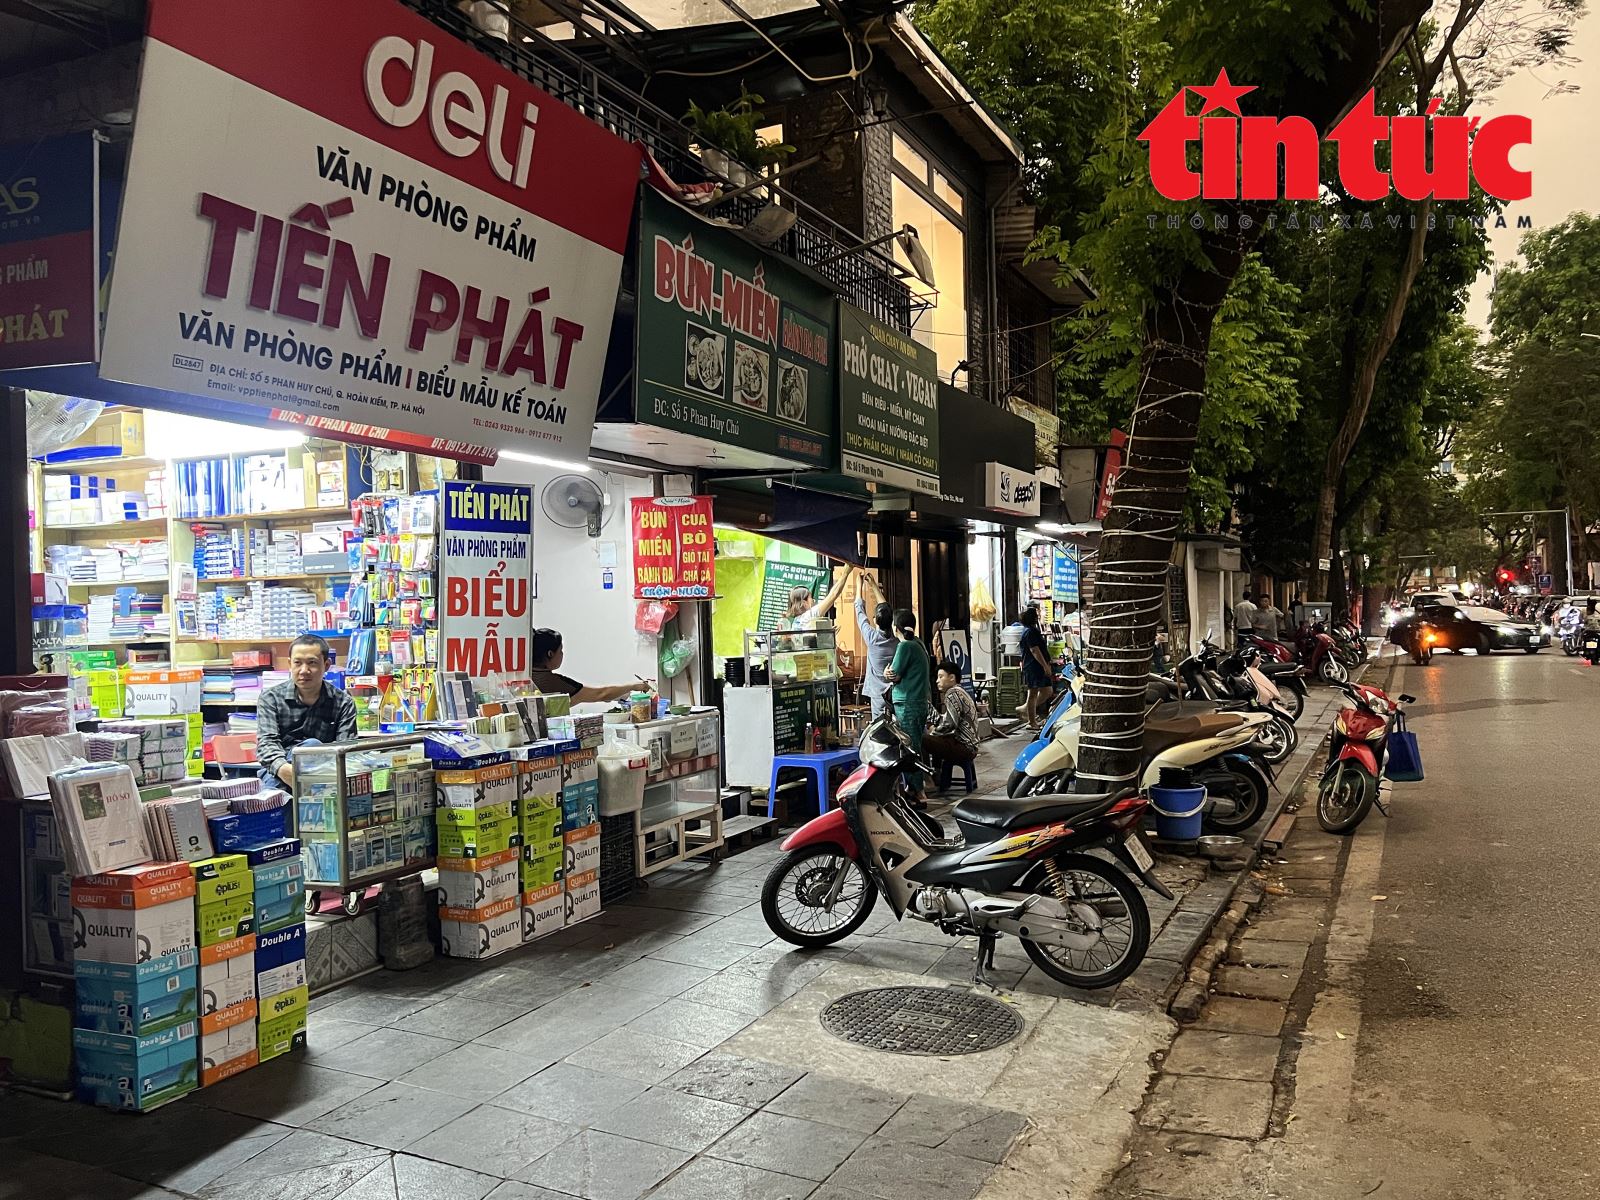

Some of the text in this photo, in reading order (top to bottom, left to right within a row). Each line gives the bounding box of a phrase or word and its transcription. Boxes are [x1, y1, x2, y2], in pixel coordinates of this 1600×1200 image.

[364, 36, 539, 189] deli
[316, 145, 537, 262] VĂN PHÒNG PHẨM
[7, 253, 48, 283] PHẨM
[199, 192, 584, 389] TIẾN PHÁT
[0, 304, 69, 344] HÁT
[179, 310, 567, 424] VĂN PHÒNG PHẨM BIỂU MẪU KẾ TOÁN
[844, 335, 937, 410] PHỞ CHAY VEGAN
[207, 379, 340, 412] Email: vpptienphat@gmail.com
[210, 363, 225, 376] ĐỊA
[229, 366, 248, 380] CHỈ:
[250, 369, 262, 382] SỐ
[264, 376, 269, 384] 5
[272, 377, 295, 390] PHAN
[297, 382, 314, 394] HUY
[346, 391, 368, 403] HOÀN
[370, 394, 388, 409] KIẾM,
[390, 402, 399, 411] TP.
[402, 402, 411, 412] HÀ
[413, 404, 425, 416] NỘI
[319, 416, 346, 432] PHAN
[654, 398, 669, 416] ĐC:
[672, 399, 681, 420] Số
[683, 406, 688, 422] 5
[690, 408, 708, 428] Phan
[710, 413, 725, 435] Huy
[912, 413, 925, 426] CHAY
[447, 438, 496, 459] 0912.877.912
[846, 431, 863, 449] THỰC
[880, 442, 896, 457] CHAY
[449, 484, 529, 521] TIẾN PHÁT
[641, 508, 667, 528] BÚN
[681, 514, 707, 526] CUA
[639, 533, 672, 556] MIẾN
[682, 530, 706, 544] BÒ
[447, 535, 526, 559] VĂN PHÒNG PHẨM
[638, 564, 674, 584] BÁNH ĐA
[684, 566, 698, 582] CHẢ
[447, 561, 527, 617] BIỂU
[446, 622, 526, 677] MẪU
[136, 693, 168, 701] QUALITY
[478, 757, 497, 766] Double
[529, 757, 556, 769] QUALITY
[481, 767, 511, 779] QUALITY
[534, 769, 560, 781] QUALITY
[263, 847, 283, 857] Double
[576, 847, 599, 860] QUALITY
[482, 856, 501, 866] QUALITY
[147, 867, 177, 879] QUALITY
[485, 872, 516, 888] QUALITY
[571, 872, 595, 887] QUALITY
[150, 882, 181, 895] QUALITY
[531, 885, 559, 900] QUALITY
[575, 889, 598, 904] QUALITY
[484, 899, 514, 917] QUALITY
[536, 905, 563, 921] QUALITY
[88, 924, 132, 938] QUALITY
[490, 920, 520, 938] QUALITY
[216, 940, 244, 952] QUALITY
[261, 934, 291, 948] Double
[161, 943, 190, 957] QUALITY
[140, 963, 164, 974] Double
[216, 1006, 244, 1021] QUALITY
[140, 1035, 164, 1047] Double
